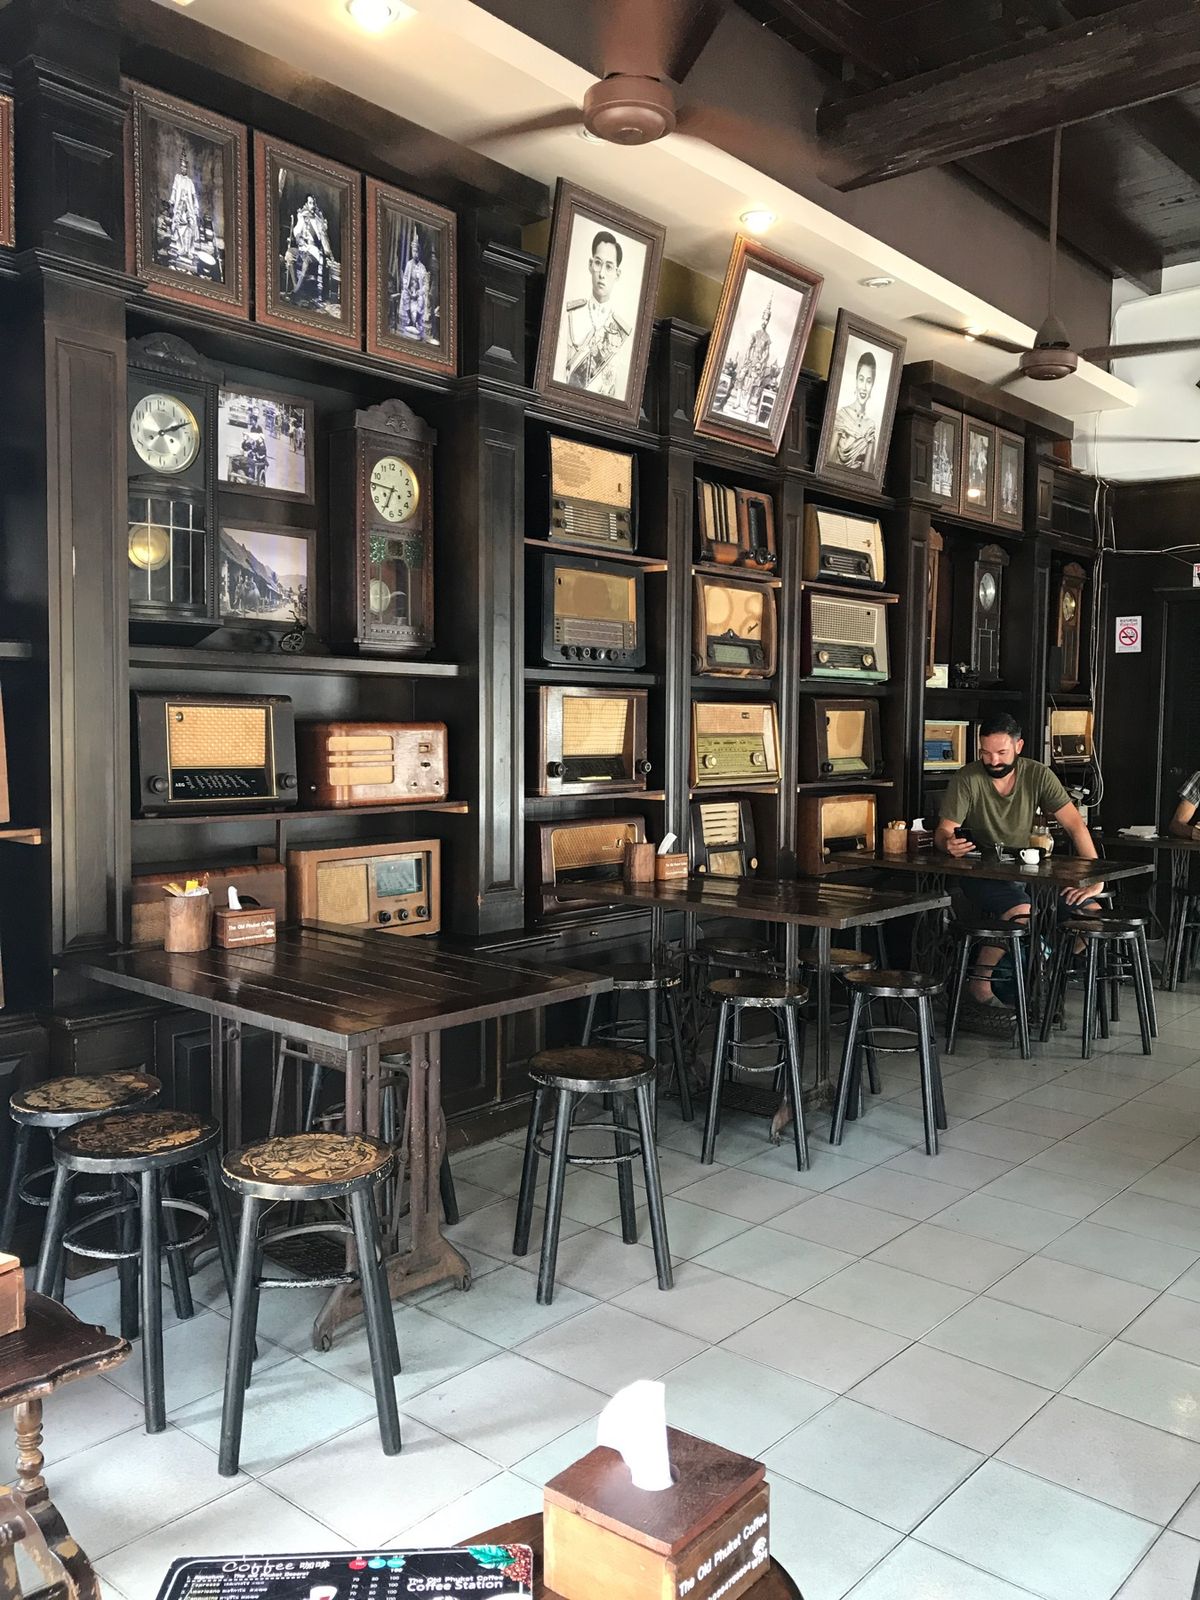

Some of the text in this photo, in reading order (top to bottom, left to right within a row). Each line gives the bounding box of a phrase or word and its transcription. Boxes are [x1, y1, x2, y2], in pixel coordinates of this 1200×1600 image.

[679, 1576, 695, 1597] The
[697, 1558, 712, 1581] Old
[713, 1533, 742, 1567] Phuket
[742, 1513, 768, 1540] Coffee
[222, 1559, 295, 1575] Coffee
[406, 1580, 503, 1592] Coffee Station
[444, 1575, 474, 1583] Phuket
